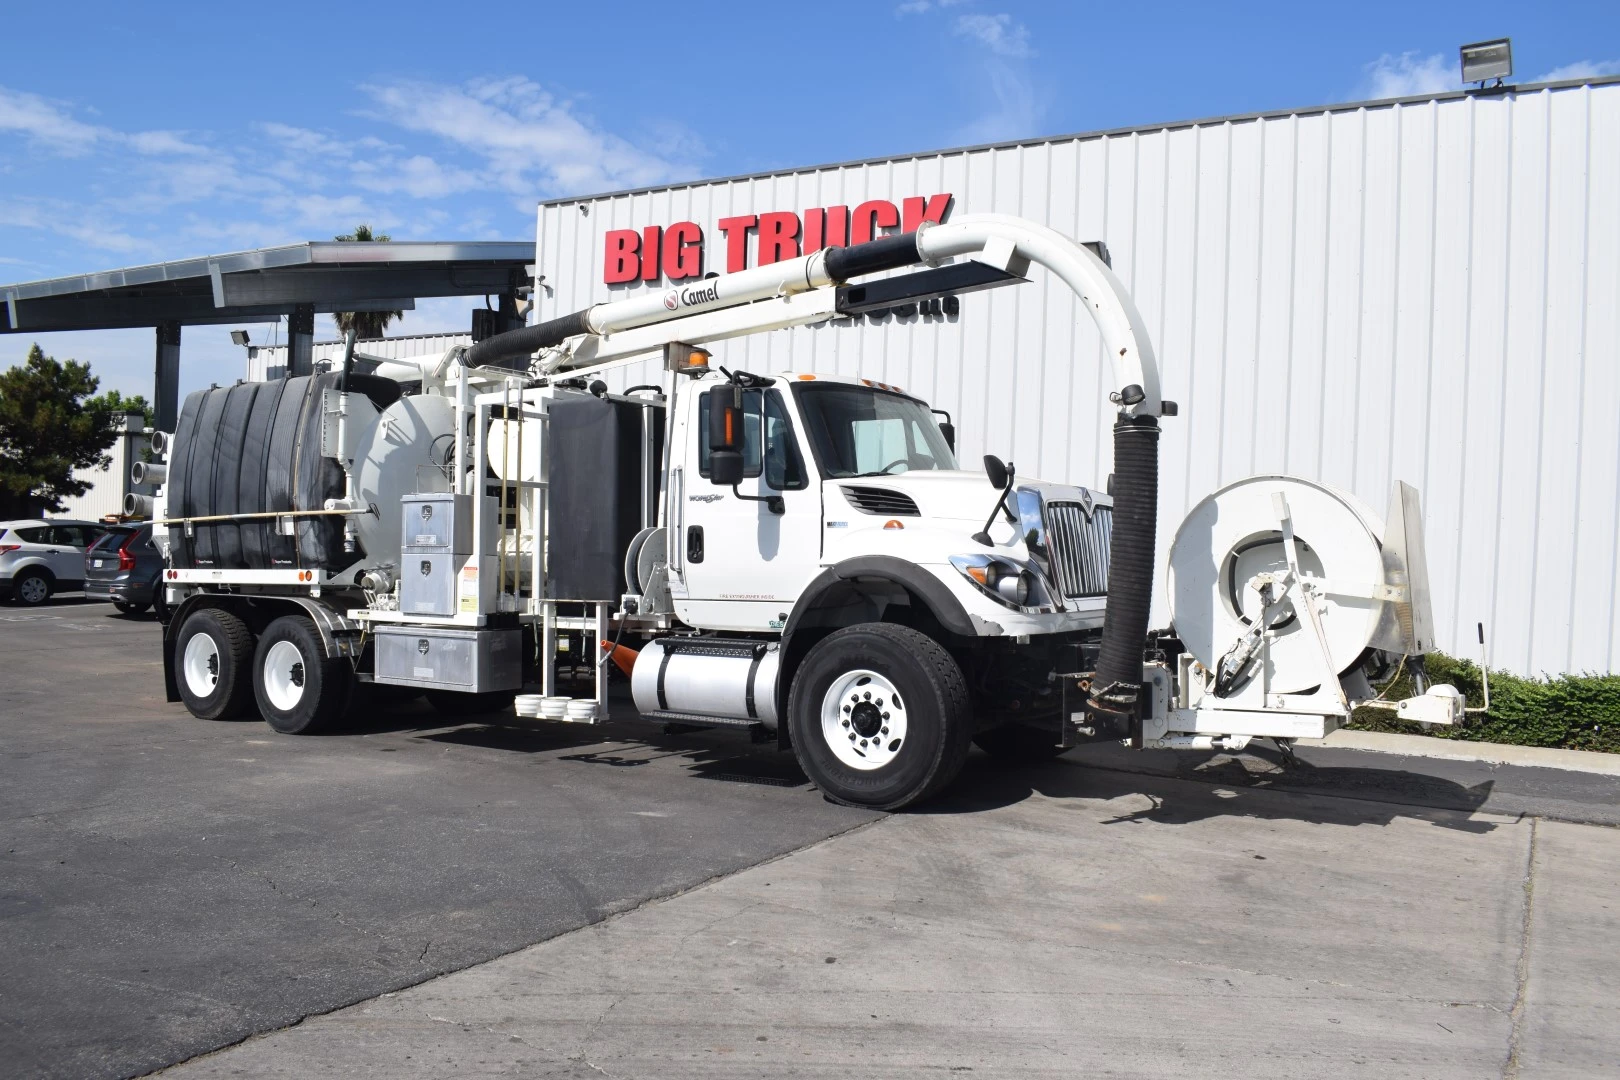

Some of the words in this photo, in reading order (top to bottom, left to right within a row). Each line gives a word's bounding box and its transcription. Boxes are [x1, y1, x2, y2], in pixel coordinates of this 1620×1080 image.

[604, 221, 702, 284] BIG
[718, 193, 953, 273] TRUCK
[681, 280, 720, 306] Camel
